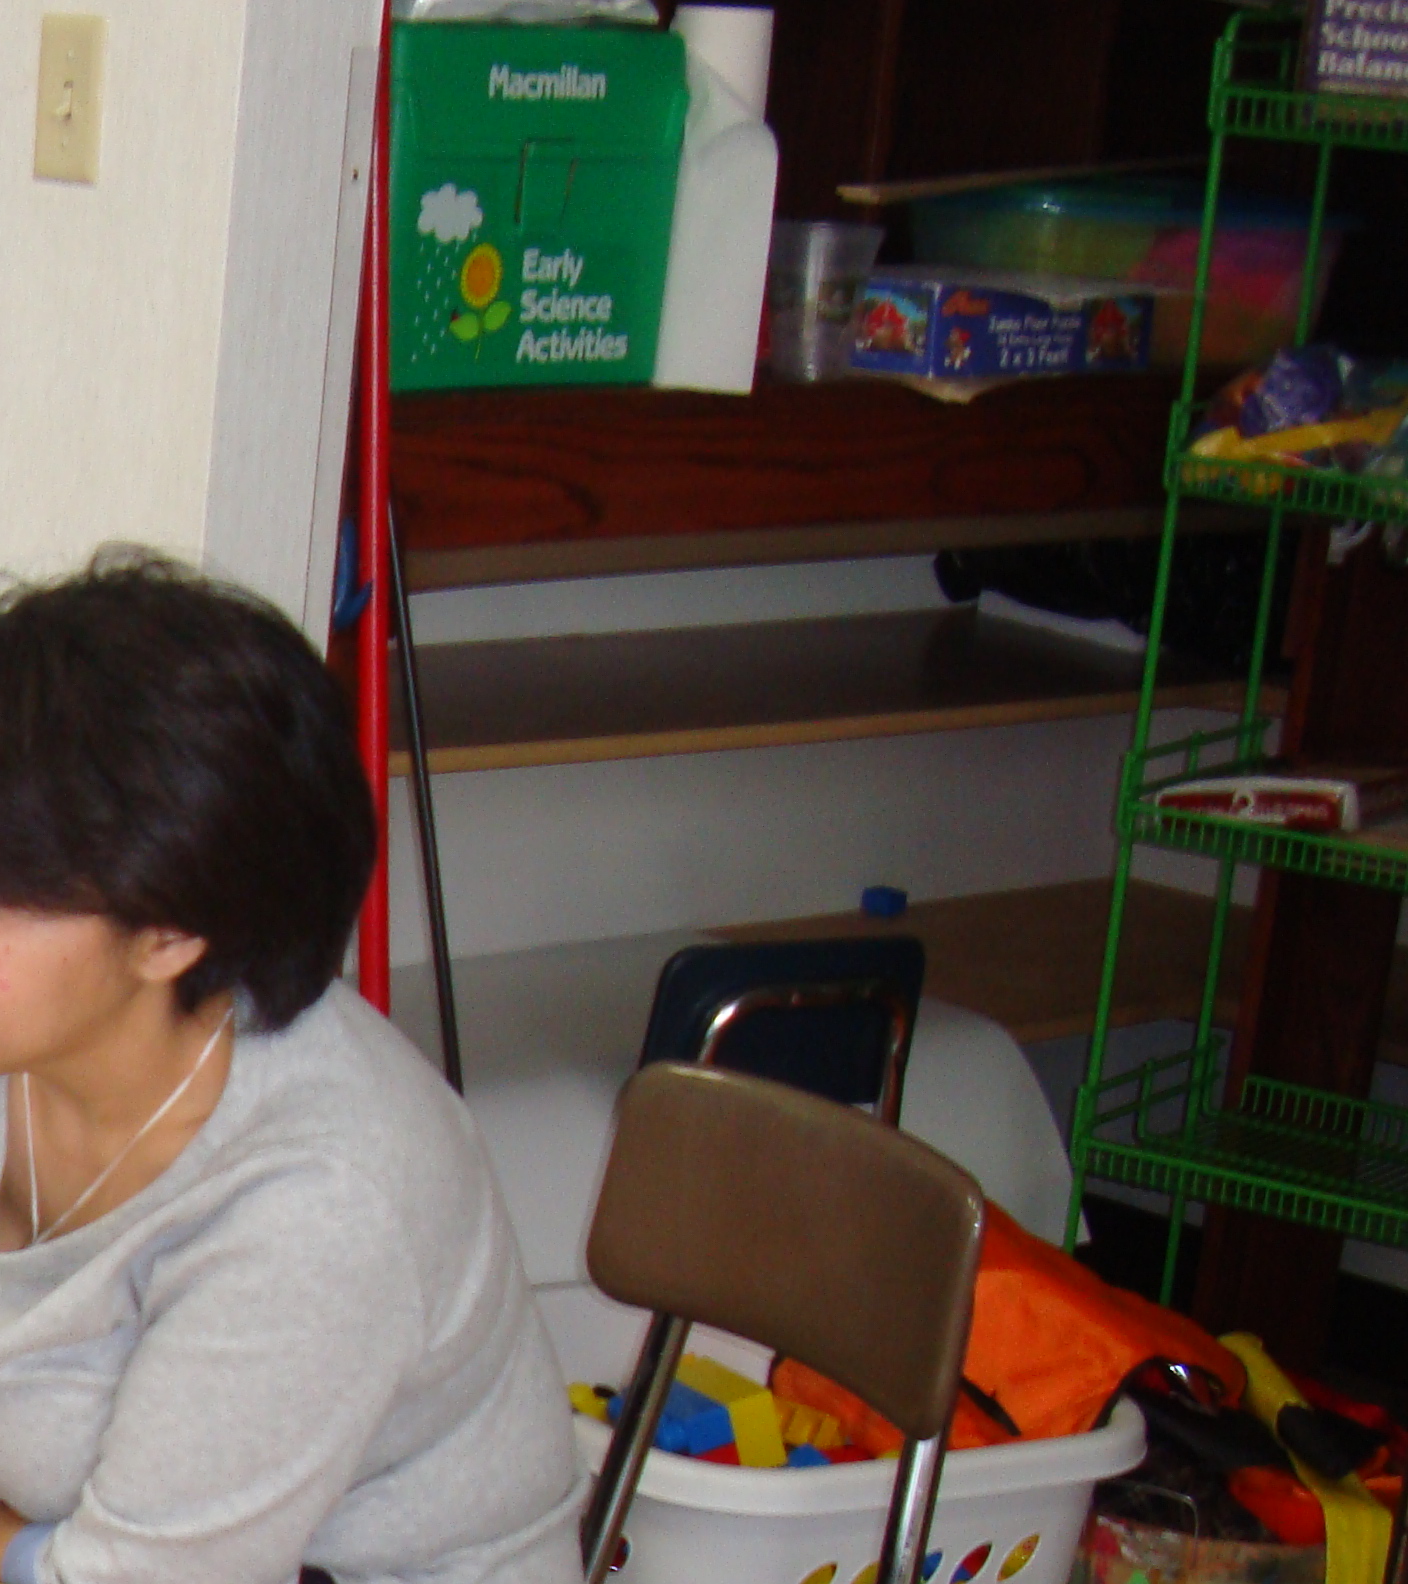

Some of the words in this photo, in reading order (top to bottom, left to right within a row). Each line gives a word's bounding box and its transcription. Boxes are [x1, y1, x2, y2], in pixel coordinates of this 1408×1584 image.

[489, 64, 606, 98] Macmillan
[522, 248, 583, 288] Early
[519, 290, 612, 323] Science
[516, 329, 628, 363] Activities
